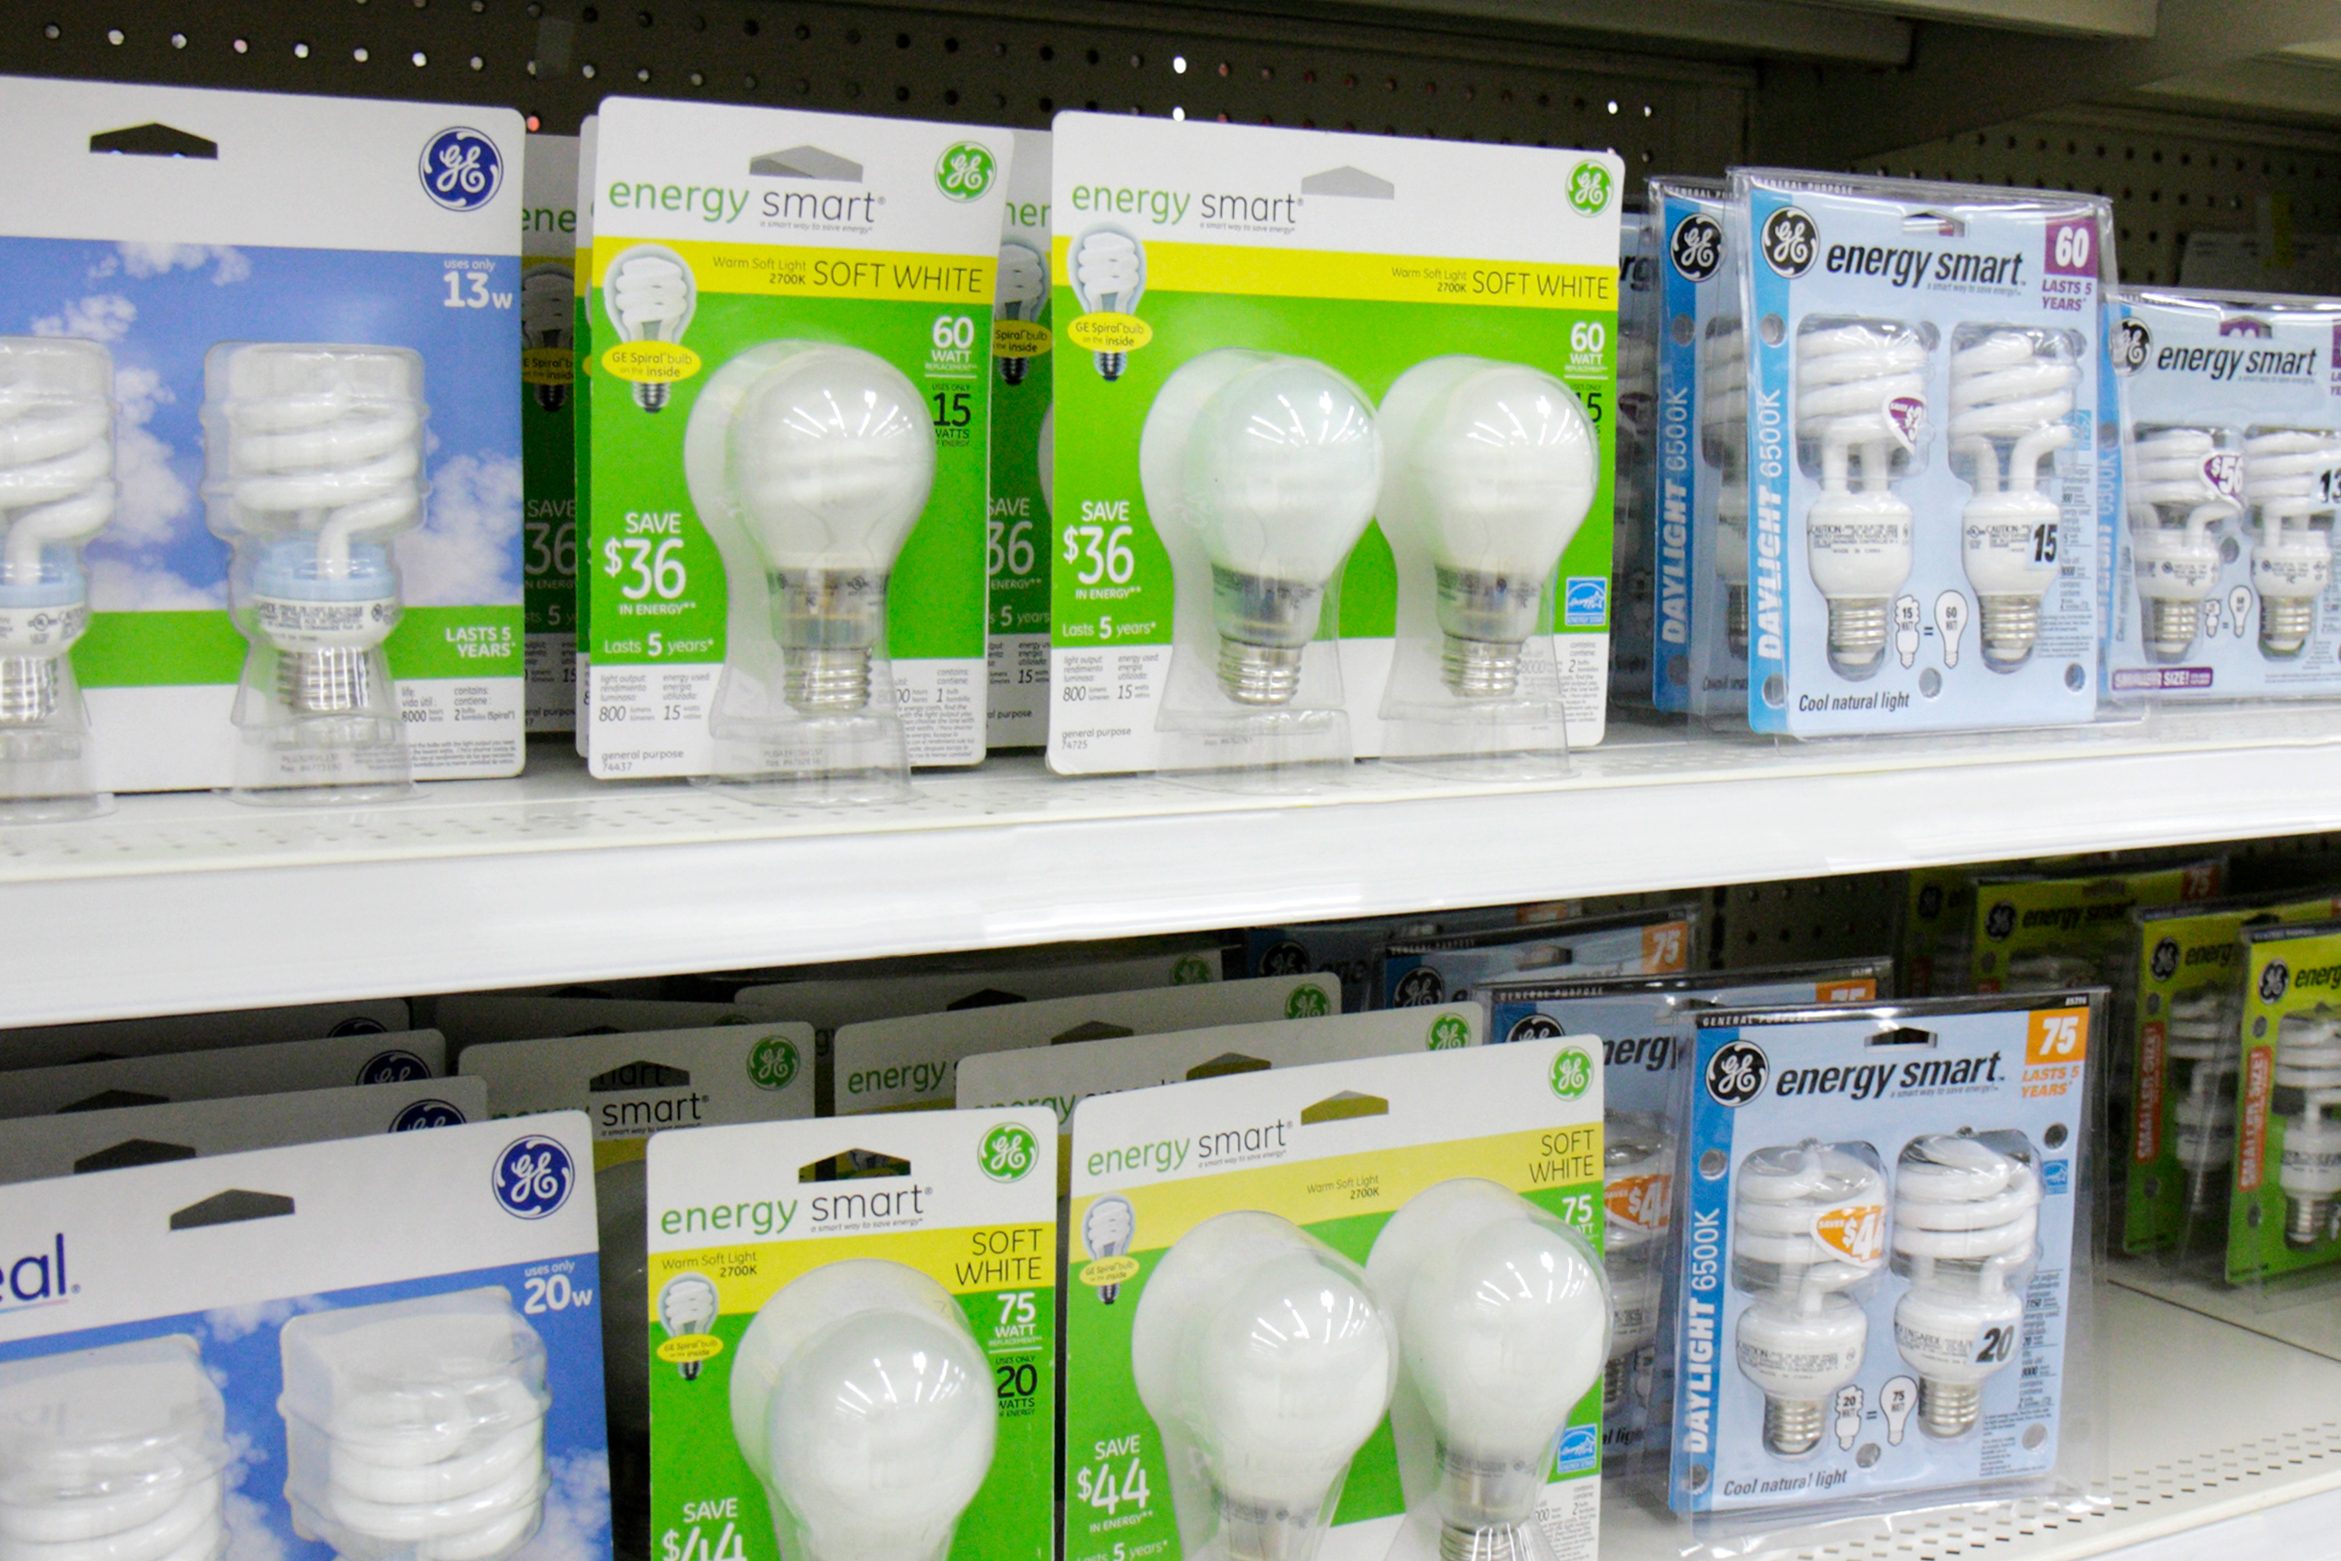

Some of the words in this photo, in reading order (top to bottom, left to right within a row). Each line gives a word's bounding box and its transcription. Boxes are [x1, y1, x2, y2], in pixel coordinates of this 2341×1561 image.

[609, 181, 750, 225] energy
[1071, 185, 1191, 225] energy
[2055, 226, 2090, 268] 60
[444, 259, 468, 269] uses
[471, 258, 495, 273] only
[713, 257, 749, 268] Warm
[752, 258, 774, 270] Soft
[778, 260, 807, 273] Light
[1392, 267, 1422, 279] Warm
[1424, 267, 1442, 280] Soft
[1444, 270, 1467, 282] Light
[1826, 244, 1932, 288] energy
[769, 274, 806, 286] 2700K
[814, 261, 885, 287] SOFT
[894, 265, 983, 293] WHITE
[1437, 282, 1467, 293] 2700K
[1472, 270, 1530, 295] SOFT
[1536, 274, 1609, 300] WHITE
[2042, 279, 2081, 295] LASTS
[2085, 282, 2092, 295] 5
[932, 316, 975, 349] 60
[1075, 322, 1089, 333] GE
[1123, 324, 1144, 335] bulb
[1570, 321, 1605, 353] 60
[1105, 336, 1134, 347] inside
[612, 352, 627, 363] GE
[667, 353, 692, 365] bulb
[931, 350, 971, 362] WATT
[1569, 353, 1603, 365] WATT
[2158, 347, 2244, 381] energy
[646, 366, 680, 377] inside
[933, 392, 971, 427] 15
[1664, 387, 1688, 472] 6500K
[1758, 388, 1782, 478] 6500K
[1081, 501, 1130, 521] SAVE
[625, 513, 681, 533] SAVE
[2033, 524, 2058, 563] 15
[1063, 525, 1134, 585] $36
[1662, 478, 1687, 644] DAYLIGHT
[604, 537, 686, 600] $36
[1757, 484, 1783, 660] DAYLIGHT
[1075, 588, 1087, 599] IN
[548, 605, 560, 626] 5
[620, 604, 630, 614] IN
[1001, 606, 1013, 626] 5
[1902, 608, 1913, 619] 15
[1946, 607, 1957, 619] 60
[445, 627, 496, 643] LASTS
[500, 626, 512, 641] 5
[1062, 623, 1095, 637] Lasts
[1099, 616, 1112, 639] 5
[604, 640, 641, 654] Lasts
[648, 632, 662, 656] 5
[1017, 669, 1033, 684] 15
[1063, 686, 1086, 701] 800
[1117, 684, 1133, 700] 15
[1799, 694, 1828, 712] Cool
[1832, 692, 1877, 711] natural
[1881, 691, 1910, 712] light
[599, 705, 626, 722] 800
[664, 704, 681, 721] 15
[1062, 729, 1094, 740] general
[1096, 727, 1131, 738] purpose
[601, 750, 641, 762] general
[642, 750, 684, 760] purpose
[1652, 929, 1680, 968] 75
[1703, 1015, 1753, 1027] GENERAL
[2039, 1016, 2079, 1056] 75
[848, 1061, 946, 1095] energy
[1776, 1062, 1897, 1101] energy
[2022, 1067, 2066, 1083] LASTS
[2071, 1066, 2080, 1079] 5
[1541, 1129, 1594, 1157] SOFT
[1088, 1138, 1190, 1176] energy
[1529, 1154, 1594, 1183] WHITE
[1307, 1180, 1335, 1194] Warm
[1336, 1178, 1354, 1190] Soft
[1356, 1174, 1379, 1189] Light
[1350, 1188, 1379, 1200] 2700K
[661, 1199, 798, 1235] energy
[1562, 1194, 1592, 1225] 75
[972, 1229, 1043, 1257] SOFT
[1692, 1208, 1721, 1291] 6500K
[524, 1265, 548, 1278] uses
[550, 1260, 575, 1275] only
[663, 1258, 698, 1270] Warm
[702, 1254, 724, 1266] Soft
[728, 1251, 757, 1265] Light
[720, 1266, 758, 1278] 2700K
[955, 1257, 1042, 1286] WHITE
[997, 1291, 1036, 1325] 75
[994, 1323, 1037, 1338] WATT
[1976, 1325, 2015, 1363] 20
[996, 1363, 1038, 1399] 20
[1684, 1298, 1715, 1454] DAYLIGHT
[1843, 1396, 1856, 1408] 20
[1892, 1390, 1905, 1402] 75
[1095, 1434, 1141, 1460] SAVE
[1077, 1457, 1150, 1515] $44
[1723, 1480, 1757, 1496] Cool
[1760, 1473, 1812, 1494] natural
[1816, 1469, 1848, 1490] light
[683, 1498, 738, 1523] SAVE
[1089, 1523, 1100, 1533] IN
